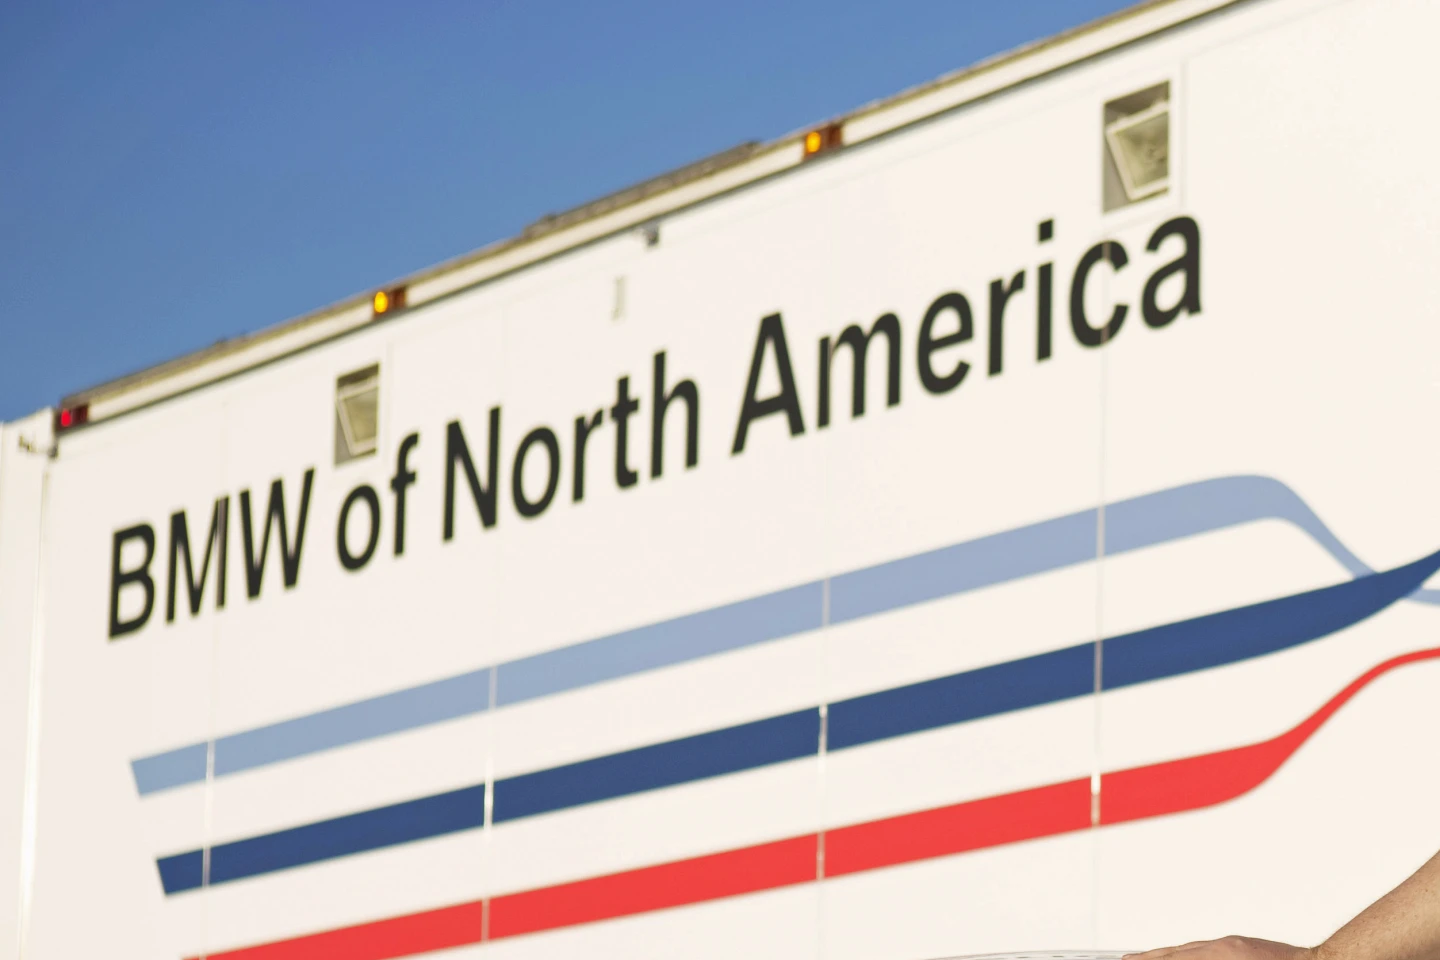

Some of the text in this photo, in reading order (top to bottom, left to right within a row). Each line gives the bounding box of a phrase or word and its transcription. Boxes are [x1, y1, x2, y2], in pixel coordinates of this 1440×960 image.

[108, 215, 1203, 641] BMW of North America
